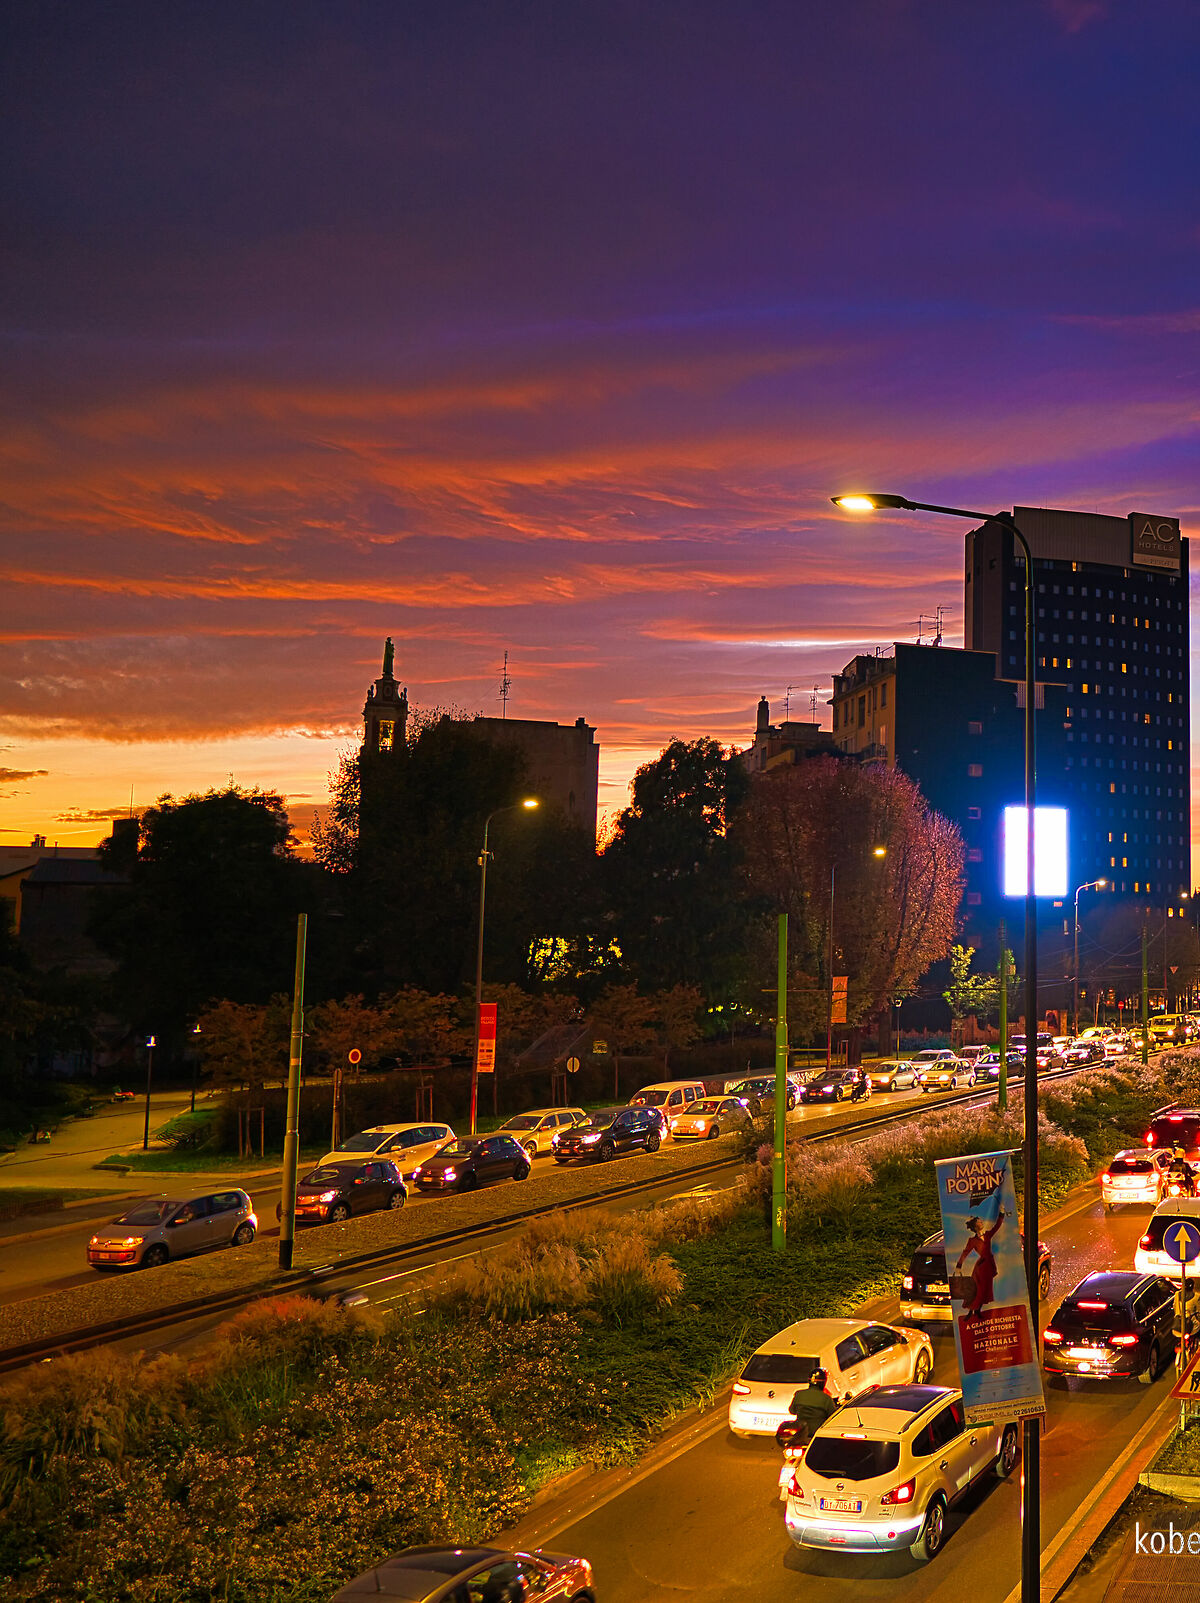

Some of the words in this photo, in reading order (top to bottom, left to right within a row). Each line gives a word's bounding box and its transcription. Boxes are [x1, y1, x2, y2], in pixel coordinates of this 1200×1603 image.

[1139, 520, 1175, 543] AC
[1138, 541, 1174, 552] HOTELS
[956, 1158, 996, 1179] MARY
[947, 1170, 1004, 1193] POPPINS
[971, 1318, 994, 1329] GRANDE
[994, 1315, 1022, 1324] RICHIESTA
[989, 1323, 1015, 1332] OTTOBRE
[974, 1335, 1018, 1350] NAZIONALE
